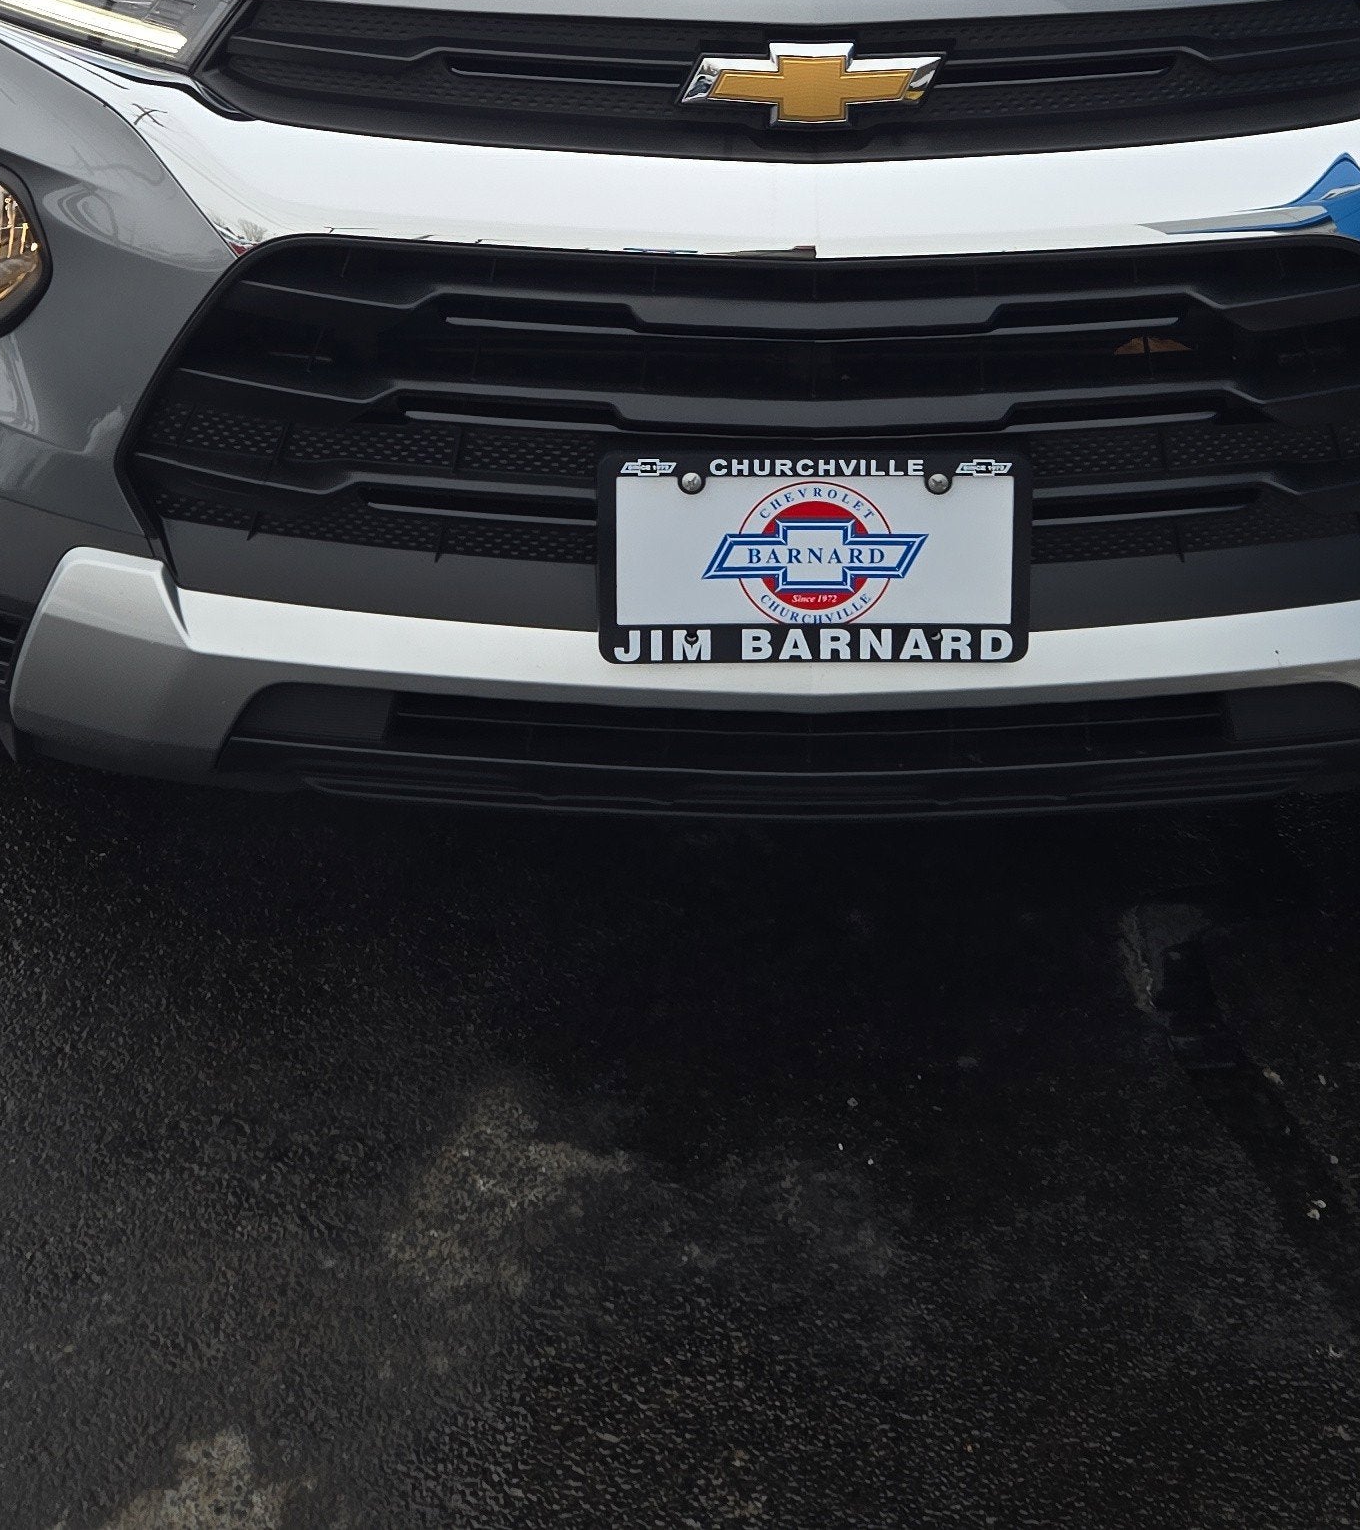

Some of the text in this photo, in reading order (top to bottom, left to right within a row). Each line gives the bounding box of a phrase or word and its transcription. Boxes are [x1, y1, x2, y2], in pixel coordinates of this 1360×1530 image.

[709, 458, 925, 476] CHURCHVILLE
[759, 486, 875, 519] CHEVROLET
[747, 547, 886, 565] BARNARD
[760, 593, 873, 625] CHURCHVILLE
[792, 594, 838, 603] Since 1972
[614, 629, 1014, 661] JIM BARNARD
